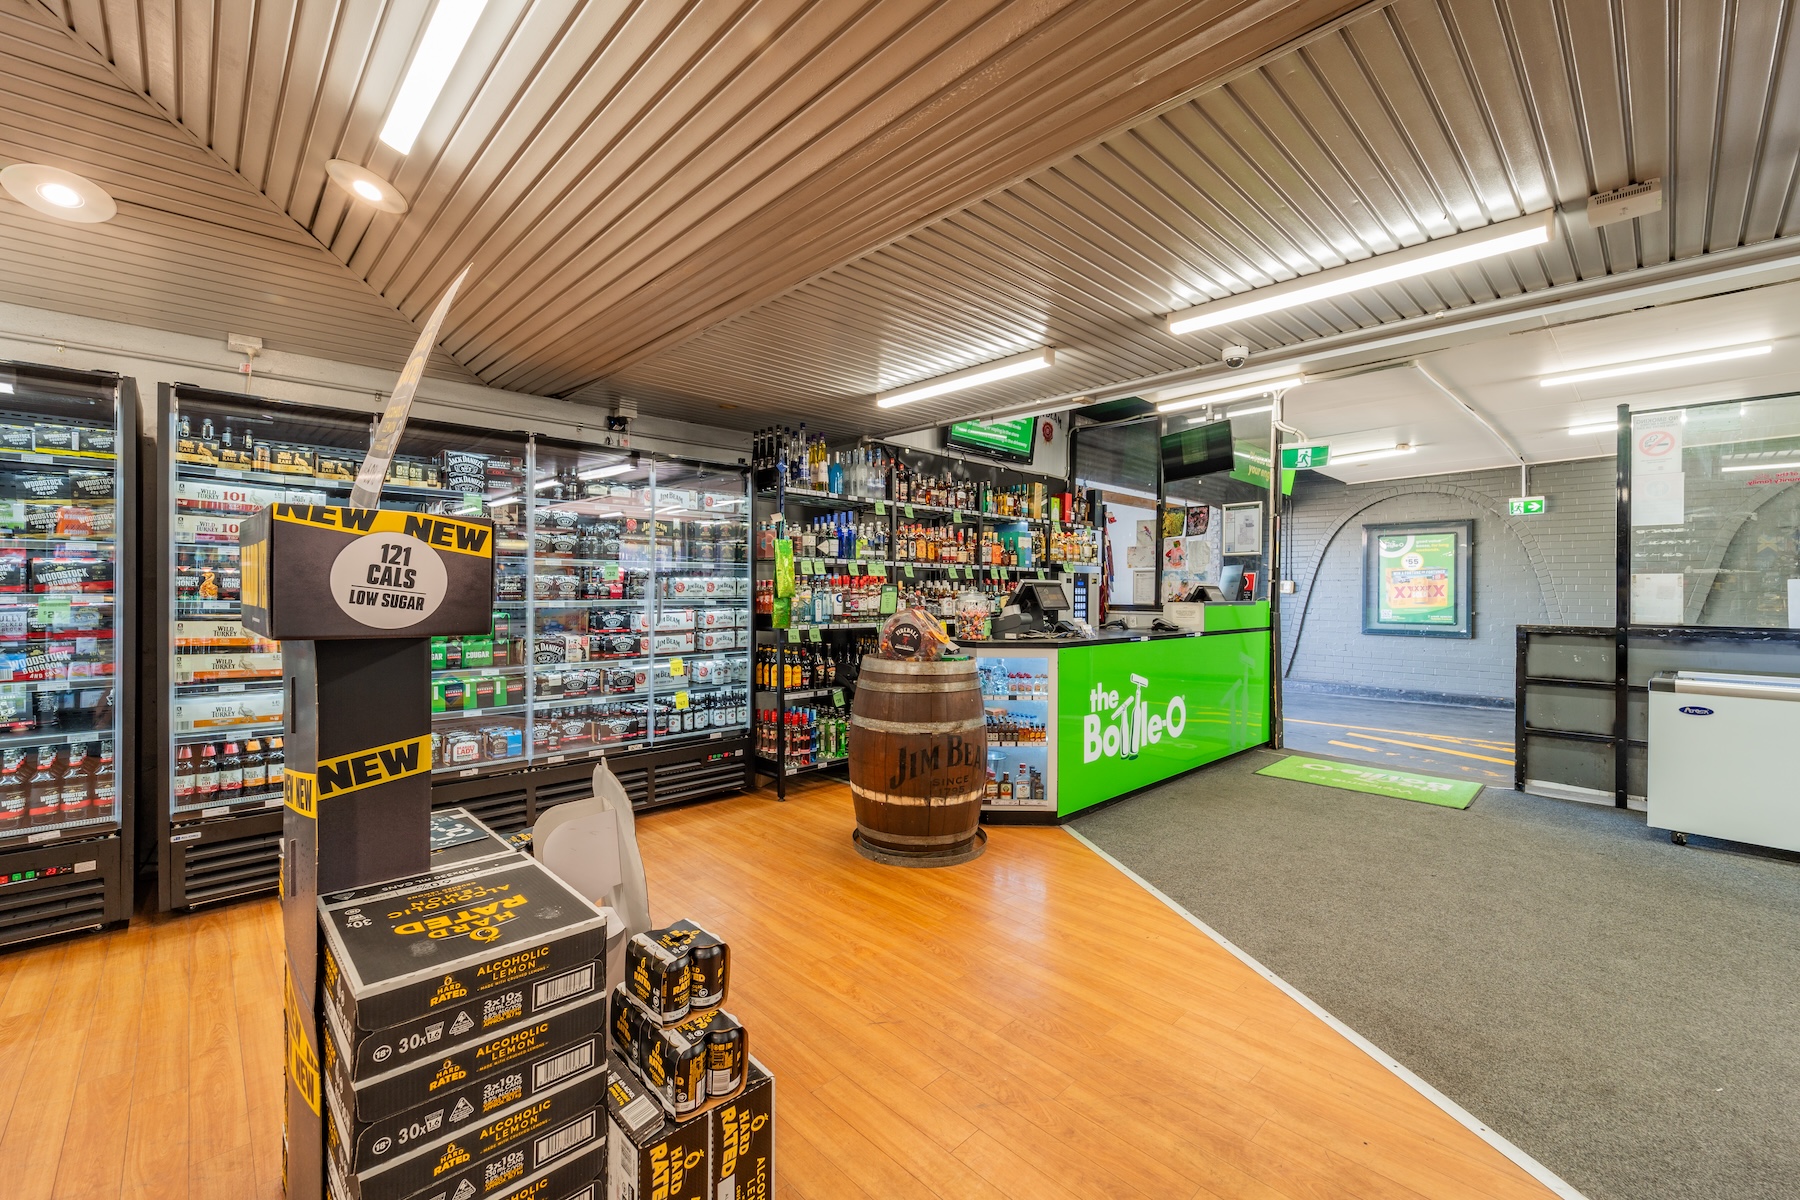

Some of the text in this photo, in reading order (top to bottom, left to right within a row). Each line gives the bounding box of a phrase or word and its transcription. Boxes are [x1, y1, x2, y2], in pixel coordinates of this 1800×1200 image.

[448, 456, 462, 466] JACK
[23, 478, 64, 489] WOODSTOCK
[76, 477, 115, 489] WOODSTOCK
[448, 476, 463, 486] JACK
[197, 491, 246, 502] TURKEY 101
[658, 492, 684, 504] JIM BEAM
[23, 511, 63, 522] WOODSTOCK
[196, 523, 239, 533] TURKEY 10
[275, 503, 489, 552] NEW NEW
[380, 542, 412, 567] 121
[36, 567, 90, 584] WOODSTOCK
[175, 579, 199, 587] HONEY
[366, 563, 417, 589] CALS
[348, 589, 425, 611] LOW SUGAR
[665, 614, 681, 626] BEAM
[655, 637, 681, 649] JIM BEAM
[895, 626, 919, 640] FIREBALL
[431, 652, 443, 660] GAR
[465, 651, 490, 659] COUGAR
[540, 643, 565, 655] DANIEL'S
[8, 650, 71, 671] WOODSTOCK
[22, 661, 63, 675] BOURBON
[1089, 682, 1119, 713] the
[317, 742, 420, 796] NEW
[889, 735, 984, 790] JIM BEA
[931, 774, 969, 787] SINCE
[939, 785, 965, 794] 1795
[295, 776, 312, 812] NEW
[386, 883, 511, 919] ALCOHOLIC
[410, 885, 485, 913] LEMON
[393, 894, 529, 936] RATED
[427, 909, 517, 940] HARD
[476, 946, 550, 977] ALCOHOLIC
[492, 960, 537, 981] LEMON
[637, 965, 649, 979] HARD
[437, 982, 461, 995] HARD
[633, 970, 651, 991] RATED
[429, 988, 467, 1007] RATED
[484, 991, 523, 1009] 3x10x
[398, 1033, 427, 1054] 30x
[428, 1030, 440, 1040] 1.6
[475, 1022, 549, 1059] ALCOHOLIC
[492, 1036, 536, 1061] LEMON
[295, 1047, 315, 1106] NEW
[435, 1064, 461, 1078] HARD
[648, 1054, 666, 1079] RATED
[429, 1070, 467, 1091] RATED
[484, 1073, 523, 1093] 3x10x
[479, 1100, 552, 1140] ALCOHOLIC
[495, 1115, 539, 1142] LEMON
[398, 1127, 427, 1145] 30x
[428, 1117, 440, 1129] 1.6
[738, 1108, 751, 1156] HARD
[720, 1105, 739, 1179] RATED
[433, 1154, 470, 1177] RATED
[440, 1148, 465, 1162] HARD
[486, 1150, 525, 1172] 3x10x
[648, 1141, 670, 1200] RATE
[670, 1145, 684, 1196] HARD
